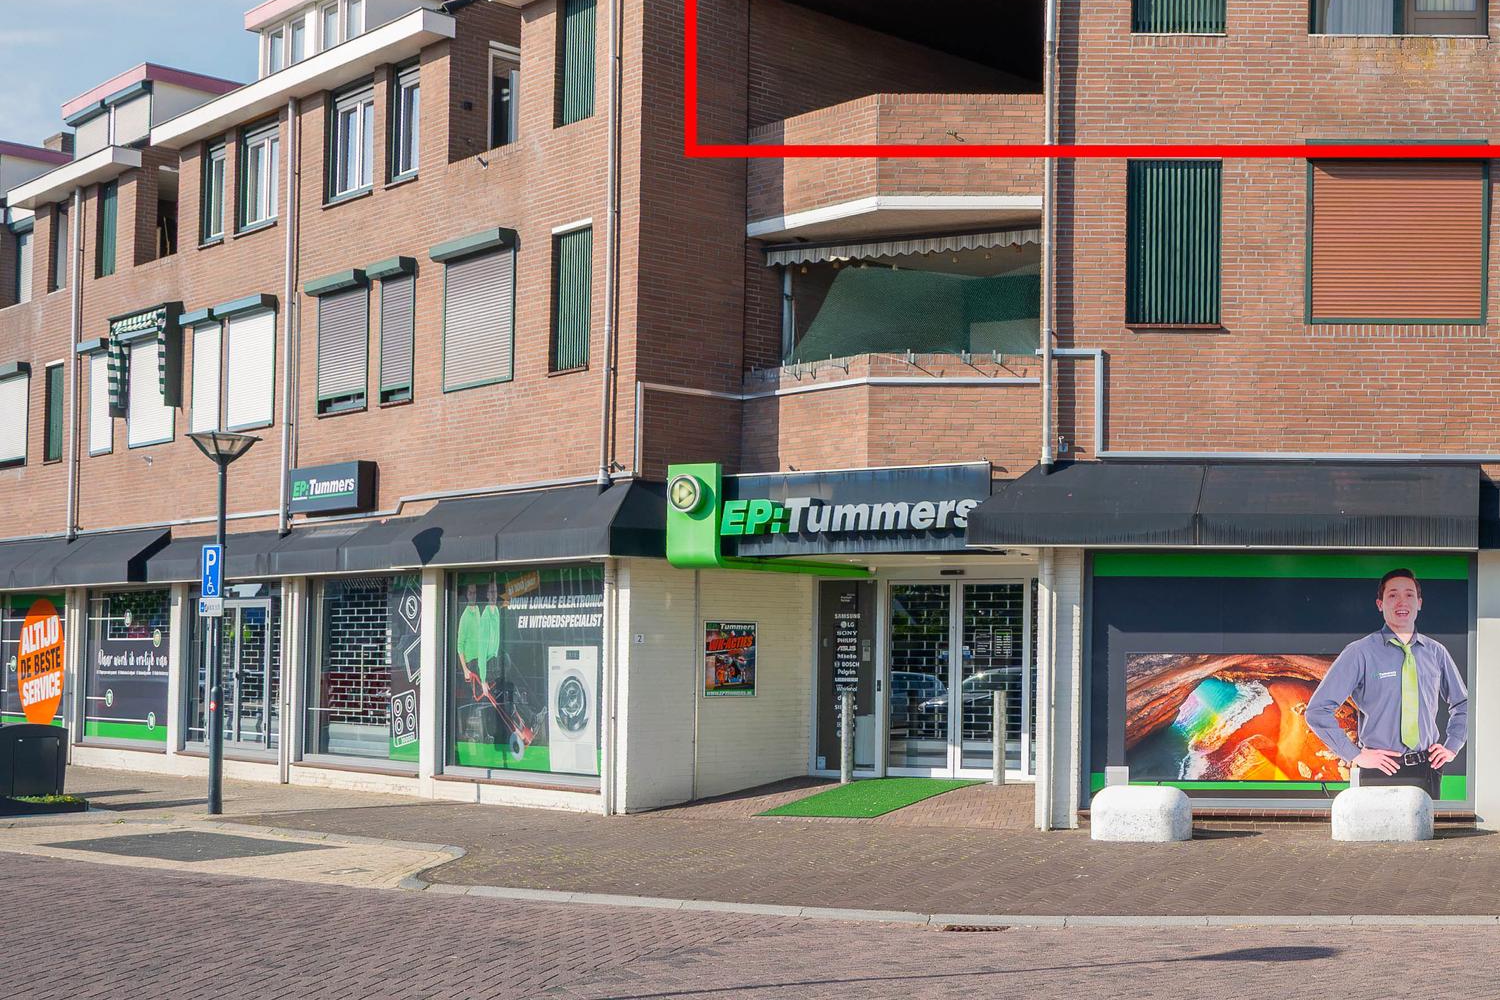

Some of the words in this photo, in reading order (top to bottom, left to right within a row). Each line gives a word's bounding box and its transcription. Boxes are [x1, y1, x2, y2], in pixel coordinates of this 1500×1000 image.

[206, 549, 217, 576] P
[508, 596, 529, 610] JOUW
[529, 595, 558, 610] LOKALE
[558, 594, 604, 608] ELEKTRONIC
[529, 614, 602, 628] WITGOEDSPECIALIST
[22, 615, 59, 655] ALTIJD
[20, 657, 32, 680] DE
[34, 646, 61, 676] BESTE
[837, 668, 856, 676] Pelgrim
[23, 672, 61, 707] SERVICE
